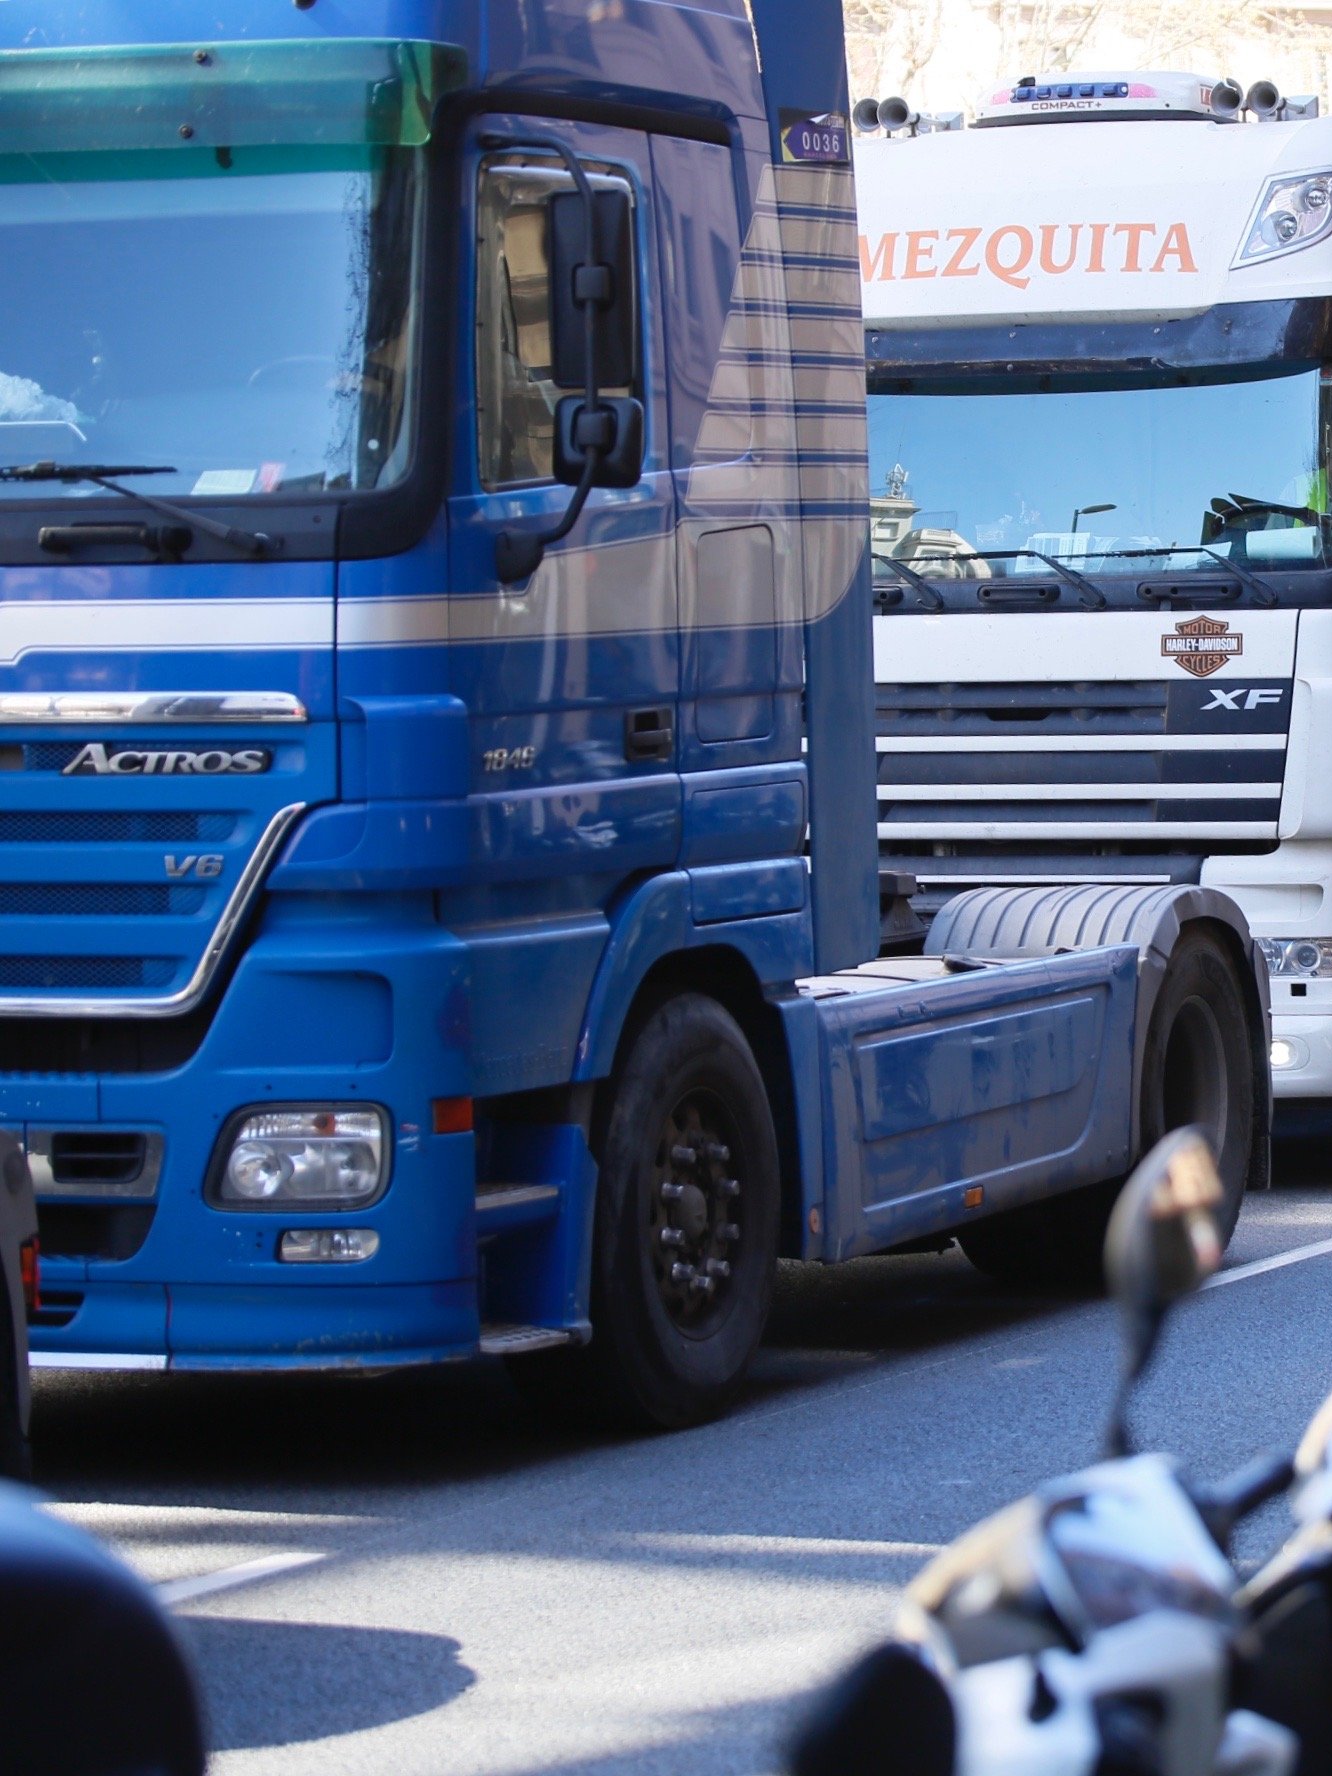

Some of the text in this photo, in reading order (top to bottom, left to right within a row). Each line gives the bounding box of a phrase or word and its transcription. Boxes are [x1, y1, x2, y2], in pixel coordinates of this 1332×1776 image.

[1031, 101, 1102, 111] COMPACT+
[802, 132, 840, 153] 0036
[858, 222, 1199, 290] MEZQUITA
[1183, 620, 1221, 634] MOTOR
[1165, 637, 1238, 652] HARLEY-DAVIDSON
[1183, 655, 1221, 673] CYCLES
[1200, 688, 1283, 710] XF
[164, 854, 224, 877] V6
